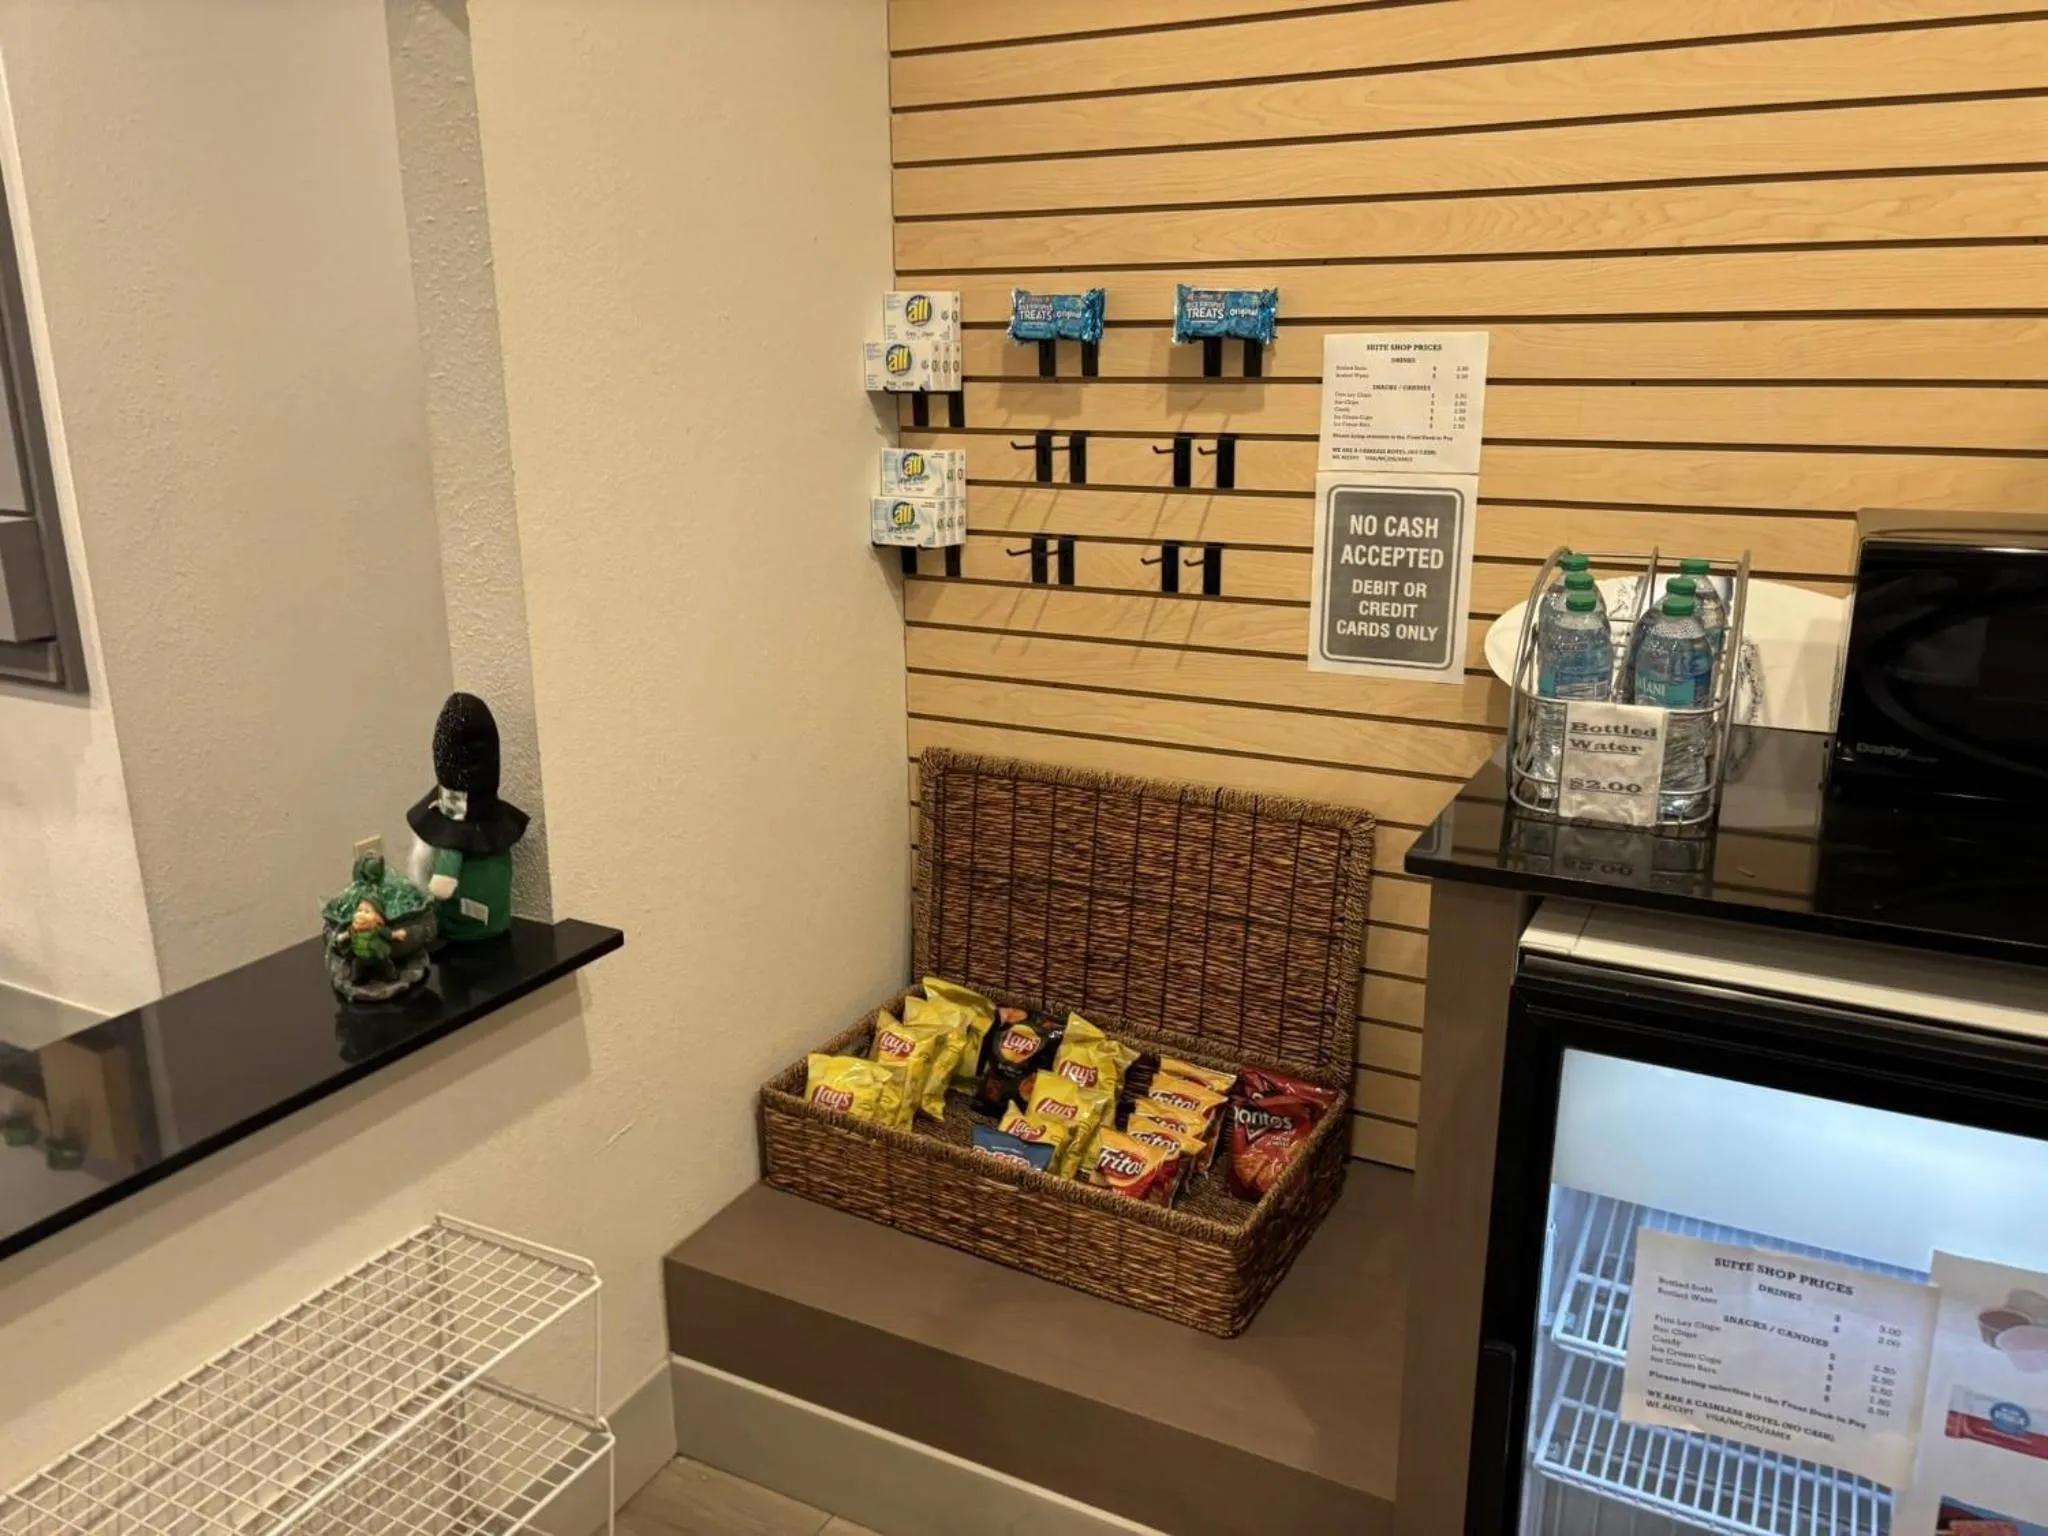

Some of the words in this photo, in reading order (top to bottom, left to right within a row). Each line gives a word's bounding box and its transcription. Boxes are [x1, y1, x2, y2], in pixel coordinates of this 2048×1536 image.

[908, 298, 928, 322] all
[1020, 310, 1052, 320] TREATS
[1186, 307, 1224, 319] TREATS
[888, 347, 908, 371] all
[904, 455, 921, 477] all
[895, 504, 913, 525] all
[1350, 515, 1378, 536] NO
[1384, 516, 1439, 539] CASH
[1340, 545, 1444, 569] ACCEPTED
[1352, 579, 1399, 597] DEBIT
[1404, 582, 1427, 598] OR
[1359, 600, 1418, 619] CREDIT
[1336, 619, 1390, 638] CARDS
[1396, 623, 1438, 641] ONLY
[1569, 721, 1657, 738] Bottled
[1569, 738, 1643, 754] Water
[1856, 742, 1908, 759] Danby
[1569, 777, 1643, 794] $2.00
[1714, 1257, 1755, 1272] SUITE
[1757, 1264, 1797, 1280] SHOP
[1800, 1273, 1854, 1296] PRICES
[1758, 1284, 1803, 1301] DRINKS
[1723, 1315, 1767, 1331] SNACKS
[1777, 1328, 1829, 1347] CANDIES
[1664, 1393, 1684, 1403] ARE
